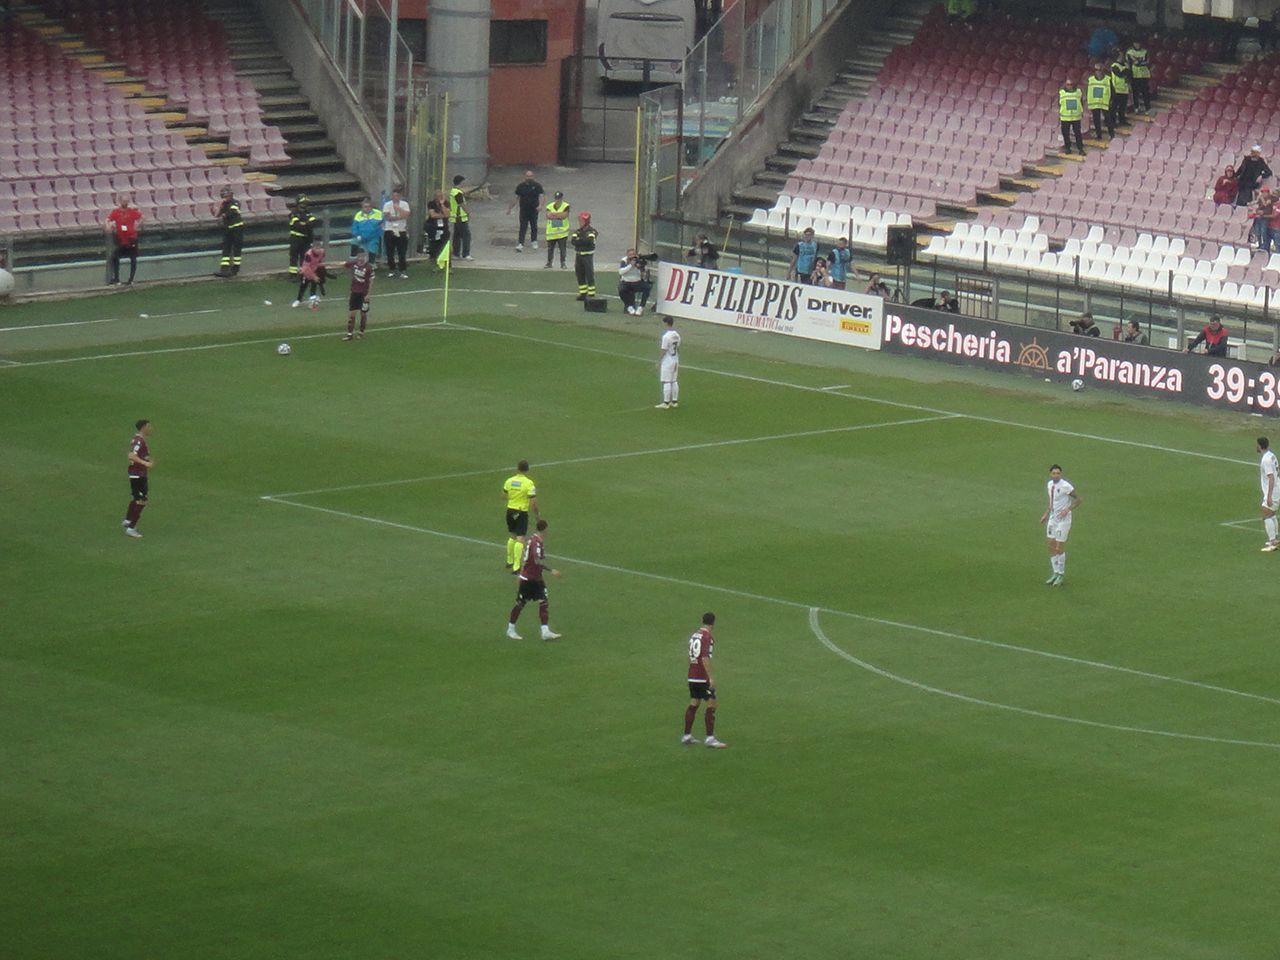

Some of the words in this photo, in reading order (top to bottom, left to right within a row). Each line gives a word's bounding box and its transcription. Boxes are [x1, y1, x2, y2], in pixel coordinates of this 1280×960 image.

[664, 267, 700, 305] DE
[701, 273, 803, 322] FILIPPIS
[885, 314, 1011, 363] Pescheria
[1057, 347, 1183, 393] a'Paranza
